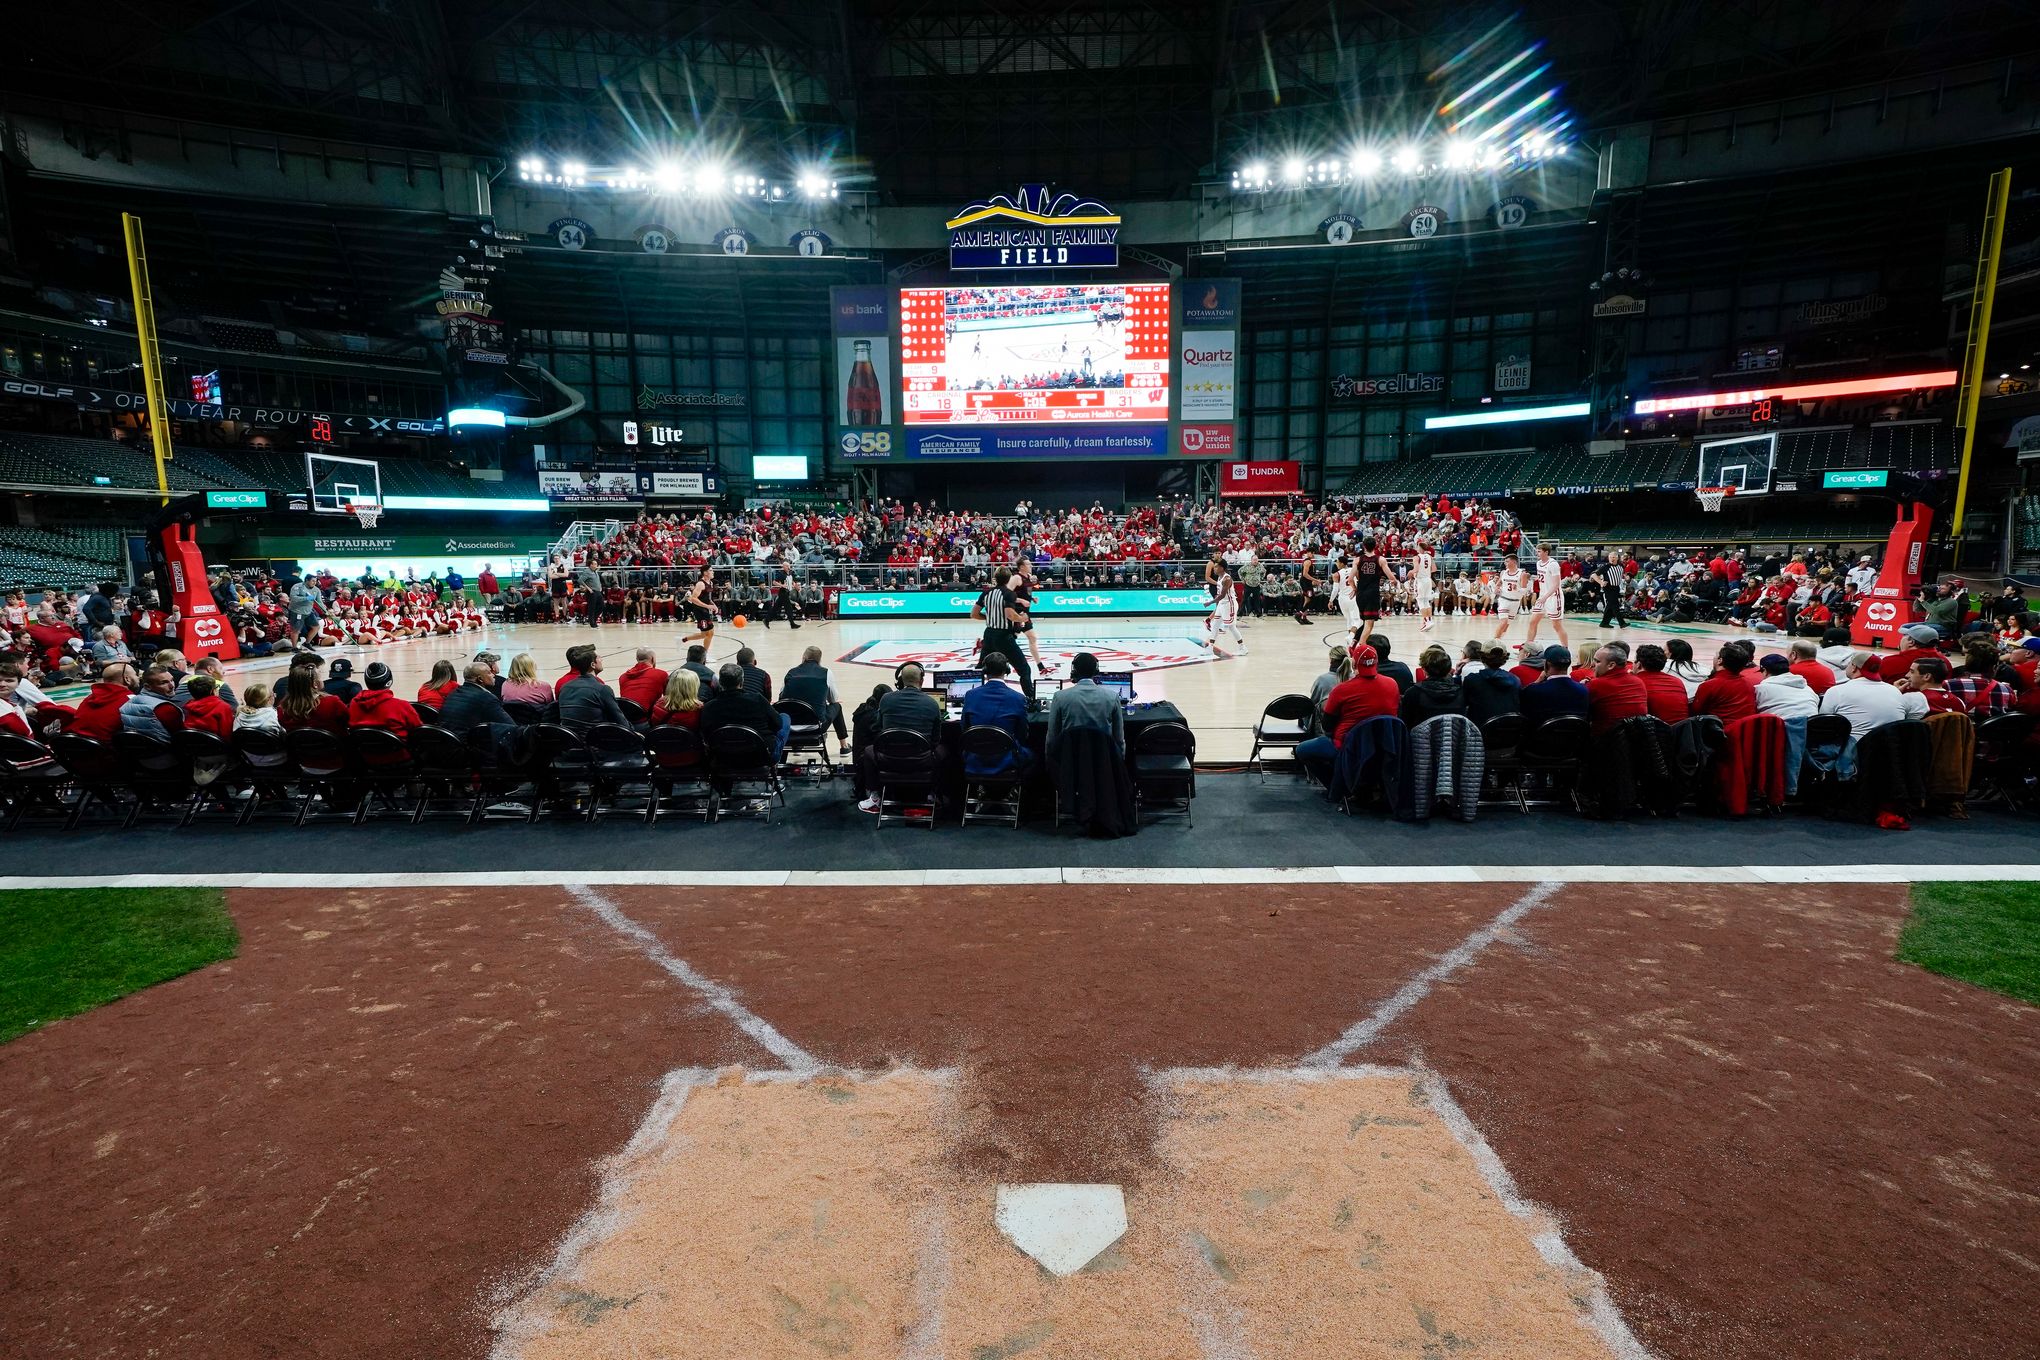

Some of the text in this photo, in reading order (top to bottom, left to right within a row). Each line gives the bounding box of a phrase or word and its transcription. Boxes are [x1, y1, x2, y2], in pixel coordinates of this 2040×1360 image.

[1409, 207, 1438, 217] UECKER
[1504, 209, 1521, 224] 19
[555, 218, 587, 230] FINGERS
[1324, 214, 1356, 225] MOLITOR
[1415, 216, 1432, 229] 50
[723, 227, 746, 236] AARON
[800, 230, 820, 238] SELIG
[1333, 226, 1344, 241] 4
[561, 230, 583, 247] 34
[645, 236, 666, 249] 42
[951, 228, 1118, 248] AMERICAN FAMILY
[725, 239, 746, 254] 44
[807, 241, 816, 256] 1
[1000, 248, 1068, 264] FIELD
[841, 304, 883, 314] us bank
[1594, 301, 1644, 316] Johnsonville
[1184, 348, 1233, 366] Quartz
[1498, 368, 1528, 378] LEINIE
[1498, 377, 1528, 388] LODGE
[938, 399, 951, 409] 18
[1119, 396, 1133, 406] 31
[4, 382, 74, 398] GOLF
[187, 402, 241, 420] YEAR
[396, 422, 445, 432] GOLF
[1752, 400, 1772, 422] 28
[1092, 410, 1114, 418] Health
[312, 420, 332, 441] 28
[651, 426, 683, 446] Lite
[860, 432, 891, 452] 58
[997, 436, 1153, 449] Insure carefully, dream fearlessly.
[1250, 468, 1285, 476] TUNDRA
[1830, 474, 1880, 484] Great Clips
[1535, 485, 1592, 496] 620 WTMJ
[213, 494, 258, 504] Great Clips
[314, 539, 392, 547] RESTAURANT
[1361, 562, 1376, 575] 42
[847, 597, 906, 608] Great Clips
[950, 597, 978, 606] Grea
[1054, 596, 1112, 606] Great Clips
[1158, 595, 1188, 604] Great
[1864, 622, 1893, 631] Aurora
[198, 638, 223, 647] Aurora
